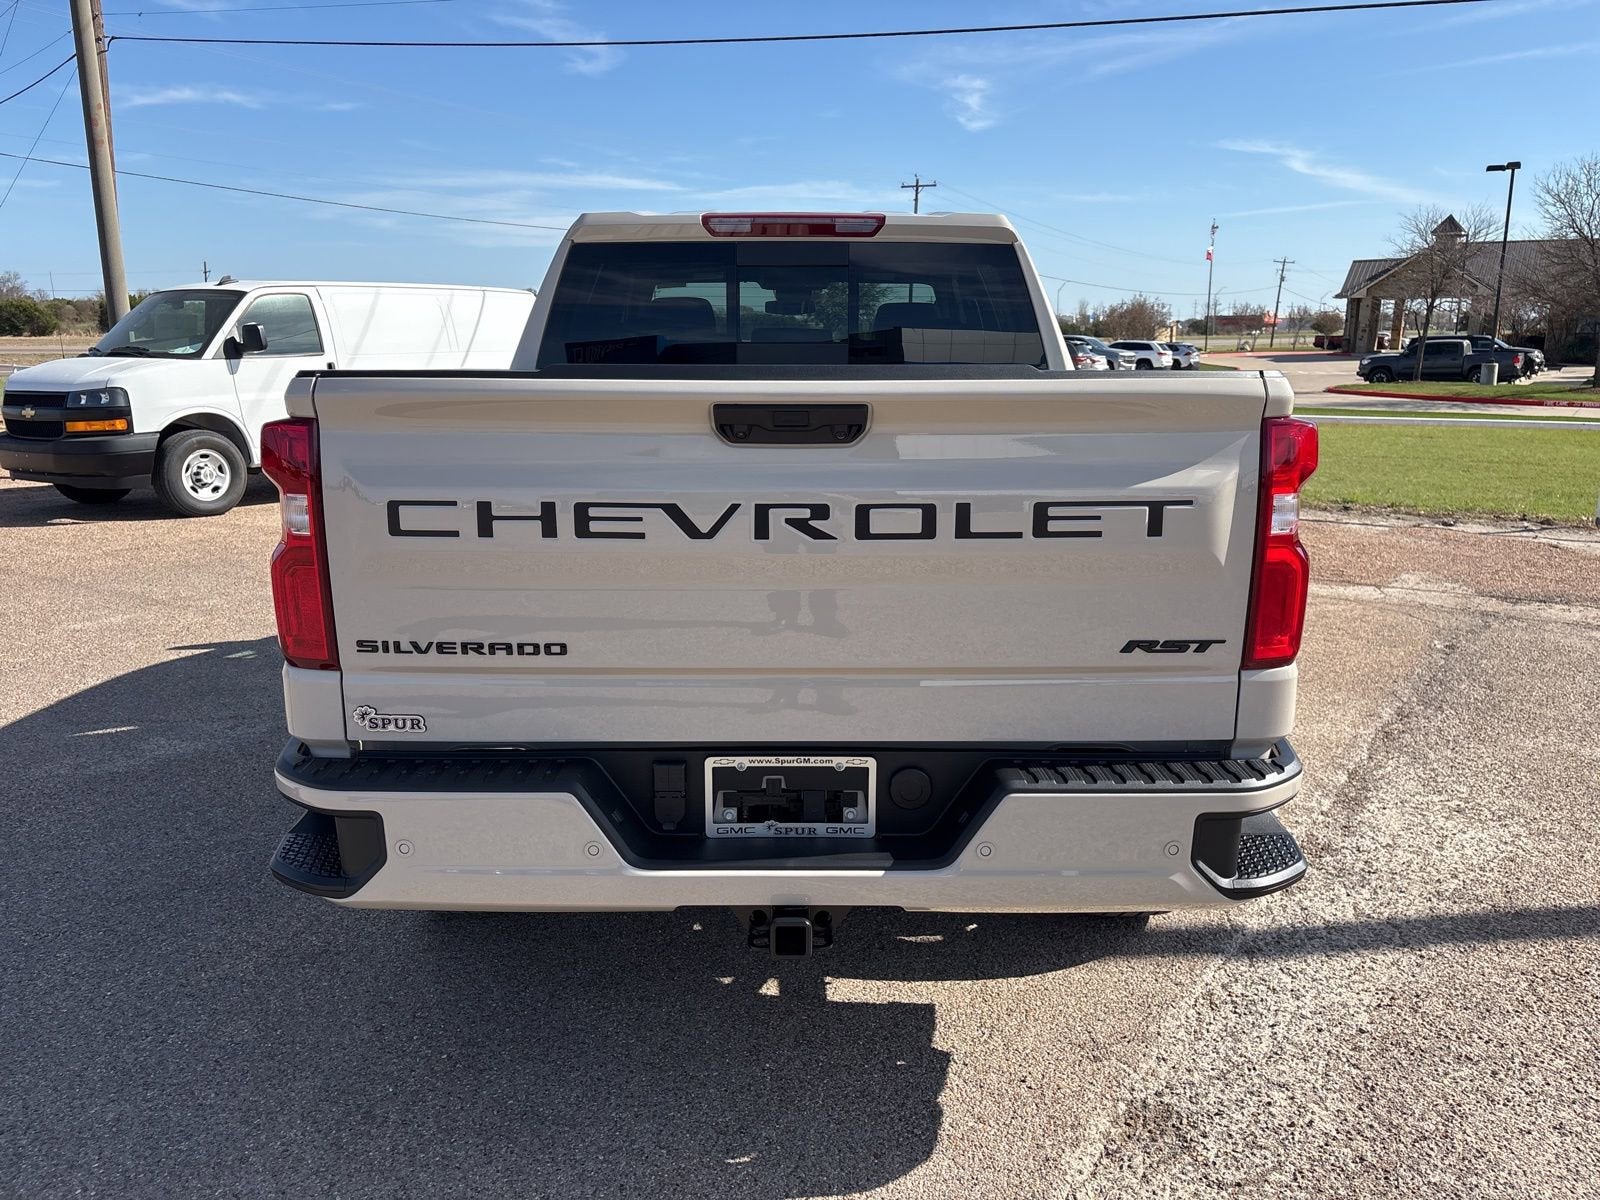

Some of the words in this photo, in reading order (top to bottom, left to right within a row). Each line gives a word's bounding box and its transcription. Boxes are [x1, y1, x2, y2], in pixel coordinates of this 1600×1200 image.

[387, 500, 1193, 540] CHEVROLET
[356, 640, 568, 656] SILVERADO
[1119, 639, 1227, 653] RST
[368, 717, 424, 731] SPUR
[748, 757, 833, 765] www.SpurGM.com
[716, 826, 756, 835] GMC
[773, 826, 818, 836] SPUR
[825, 826, 865, 835] GMC
